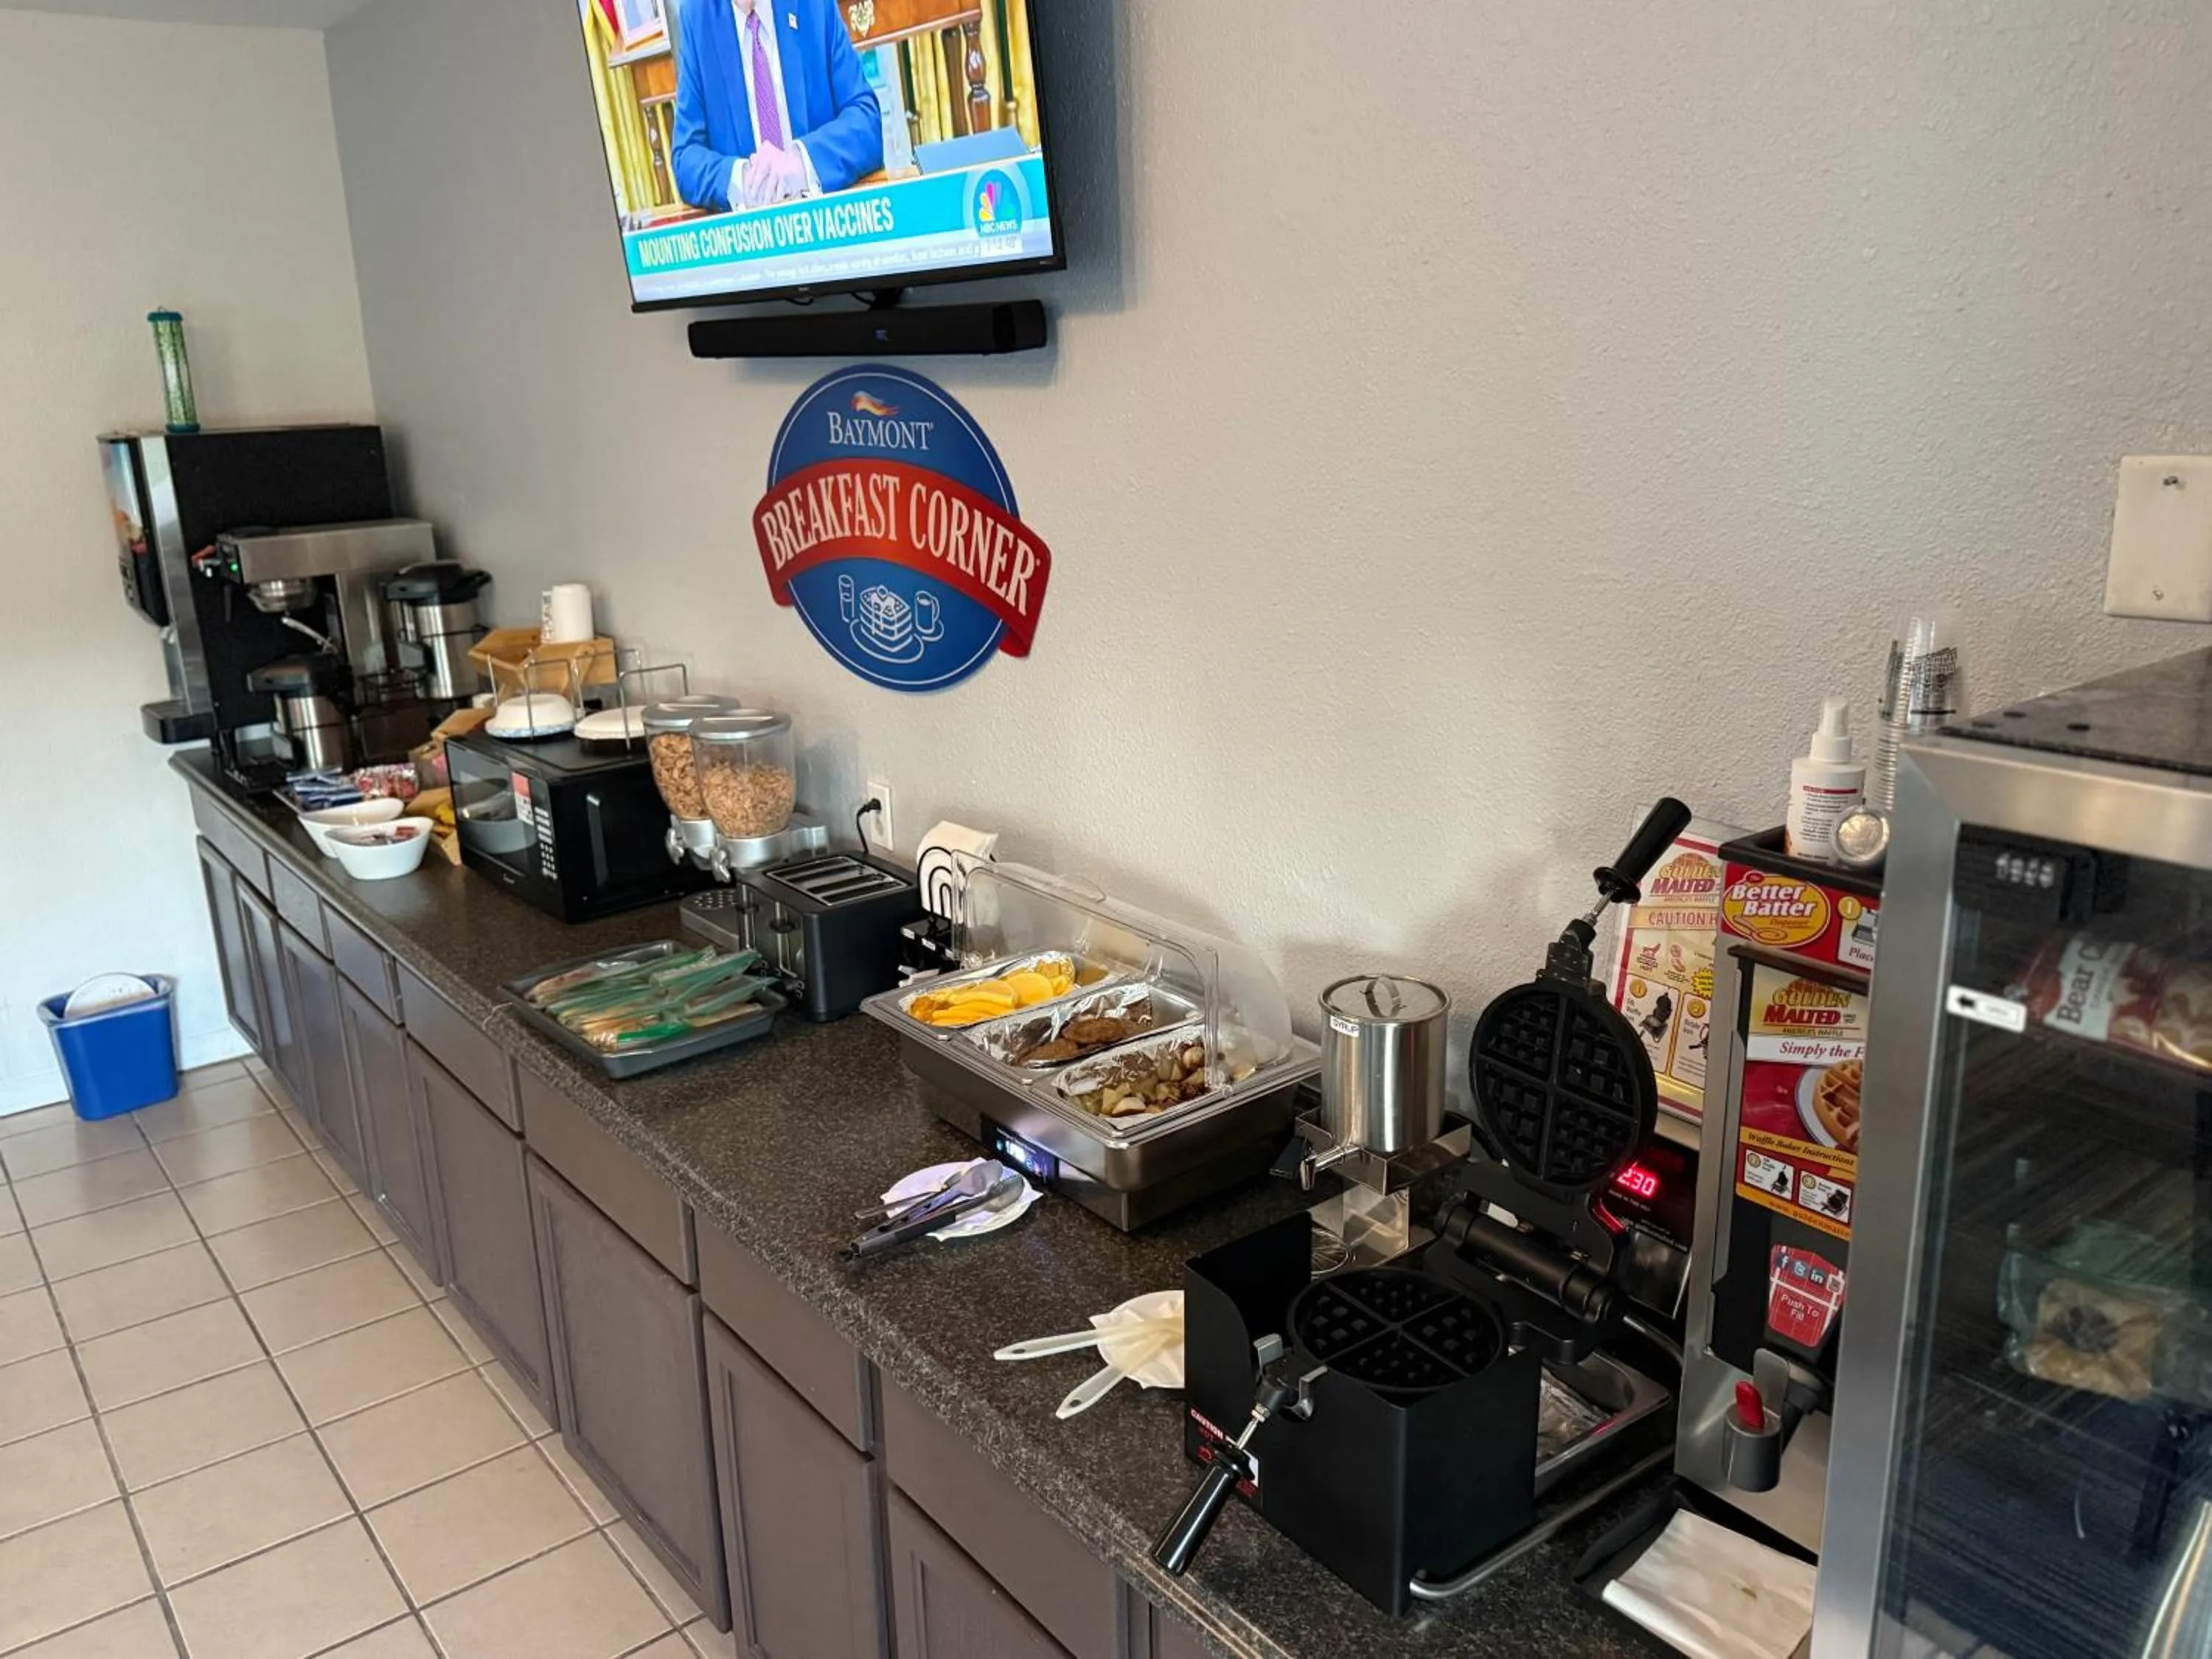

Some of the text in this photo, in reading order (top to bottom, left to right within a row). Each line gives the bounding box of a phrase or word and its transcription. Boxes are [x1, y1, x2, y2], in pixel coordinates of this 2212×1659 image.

[638, 198, 894, 268] MOUNTING CONFUSION OVER VACCINES
[827, 412, 931, 451] BAYMONT
[762, 473, 1036, 617] BREAKFAST CORNER
[1651, 878, 1715, 894] MALTED
[1731, 883, 1805, 901] Better
[1742, 900, 1816, 917] Batter
[1648, 912, 1705, 925] CAUTION
[1772, 989, 1851, 1008] GOLDEN
[2056, 964, 2094, 1025] Bear
[1763, 1004, 1841, 1024] MALTED
[1779, 1041, 1827, 1058] Simply
[1829, 1045, 1851, 1057] the
[1802, 1147, 1854, 1166] Instructions
[1781, 1294, 1805, 1311] Push
